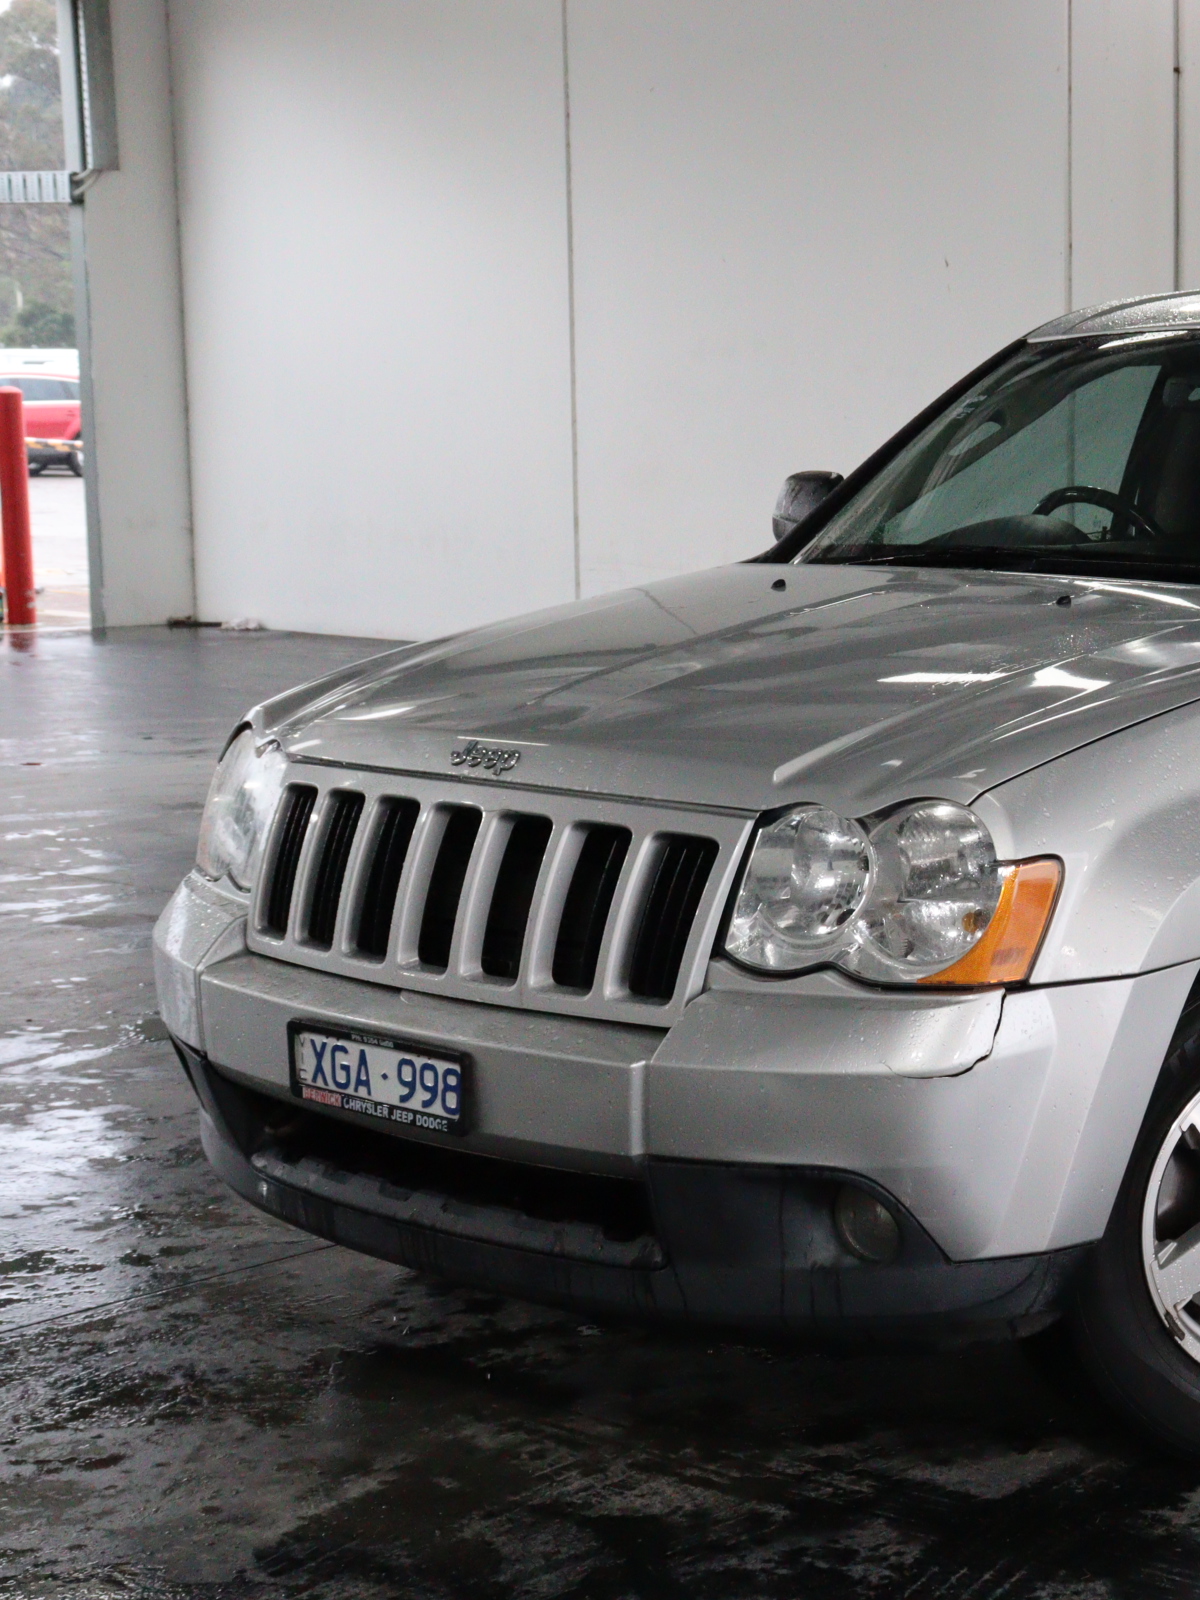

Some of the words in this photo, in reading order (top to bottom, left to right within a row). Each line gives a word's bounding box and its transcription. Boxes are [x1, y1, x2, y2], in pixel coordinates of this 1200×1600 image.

[449, 739, 521, 776] Jeep
[343, 1098, 389, 1118] CHRYSLER
[391, 1108, 414, 1124] JEEP
[416, 1114, 448, 1132] DODGE
